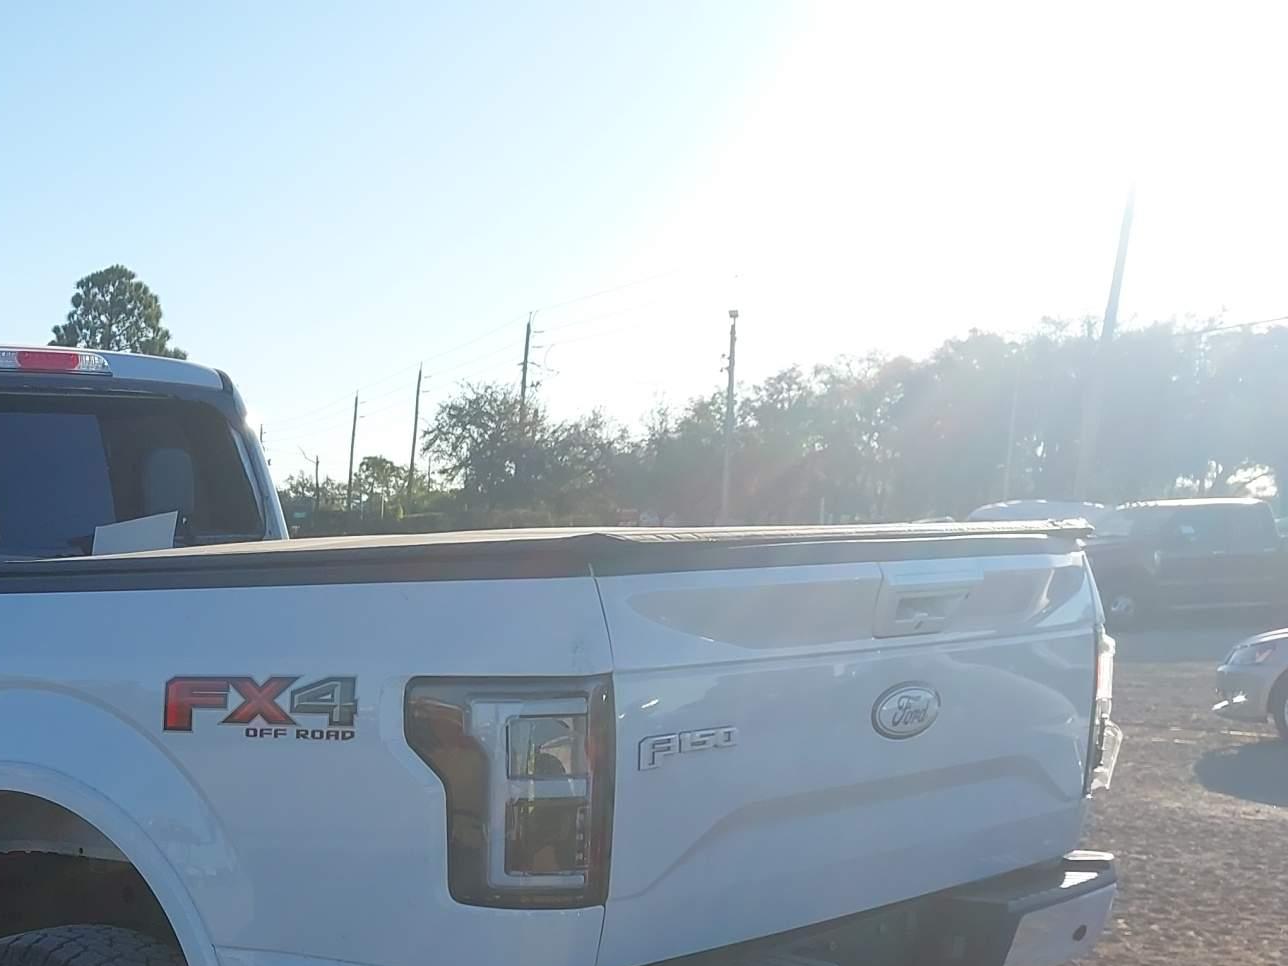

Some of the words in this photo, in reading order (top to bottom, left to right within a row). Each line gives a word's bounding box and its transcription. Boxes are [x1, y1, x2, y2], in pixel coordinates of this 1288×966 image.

[163, 676, 359, 732] FX4
[892, 695, 930, 727] Ford
[245, 727, 288, 739] OFF
[295, 728, 355, 741] ROAD
[638, 725, 739, 771] F150
